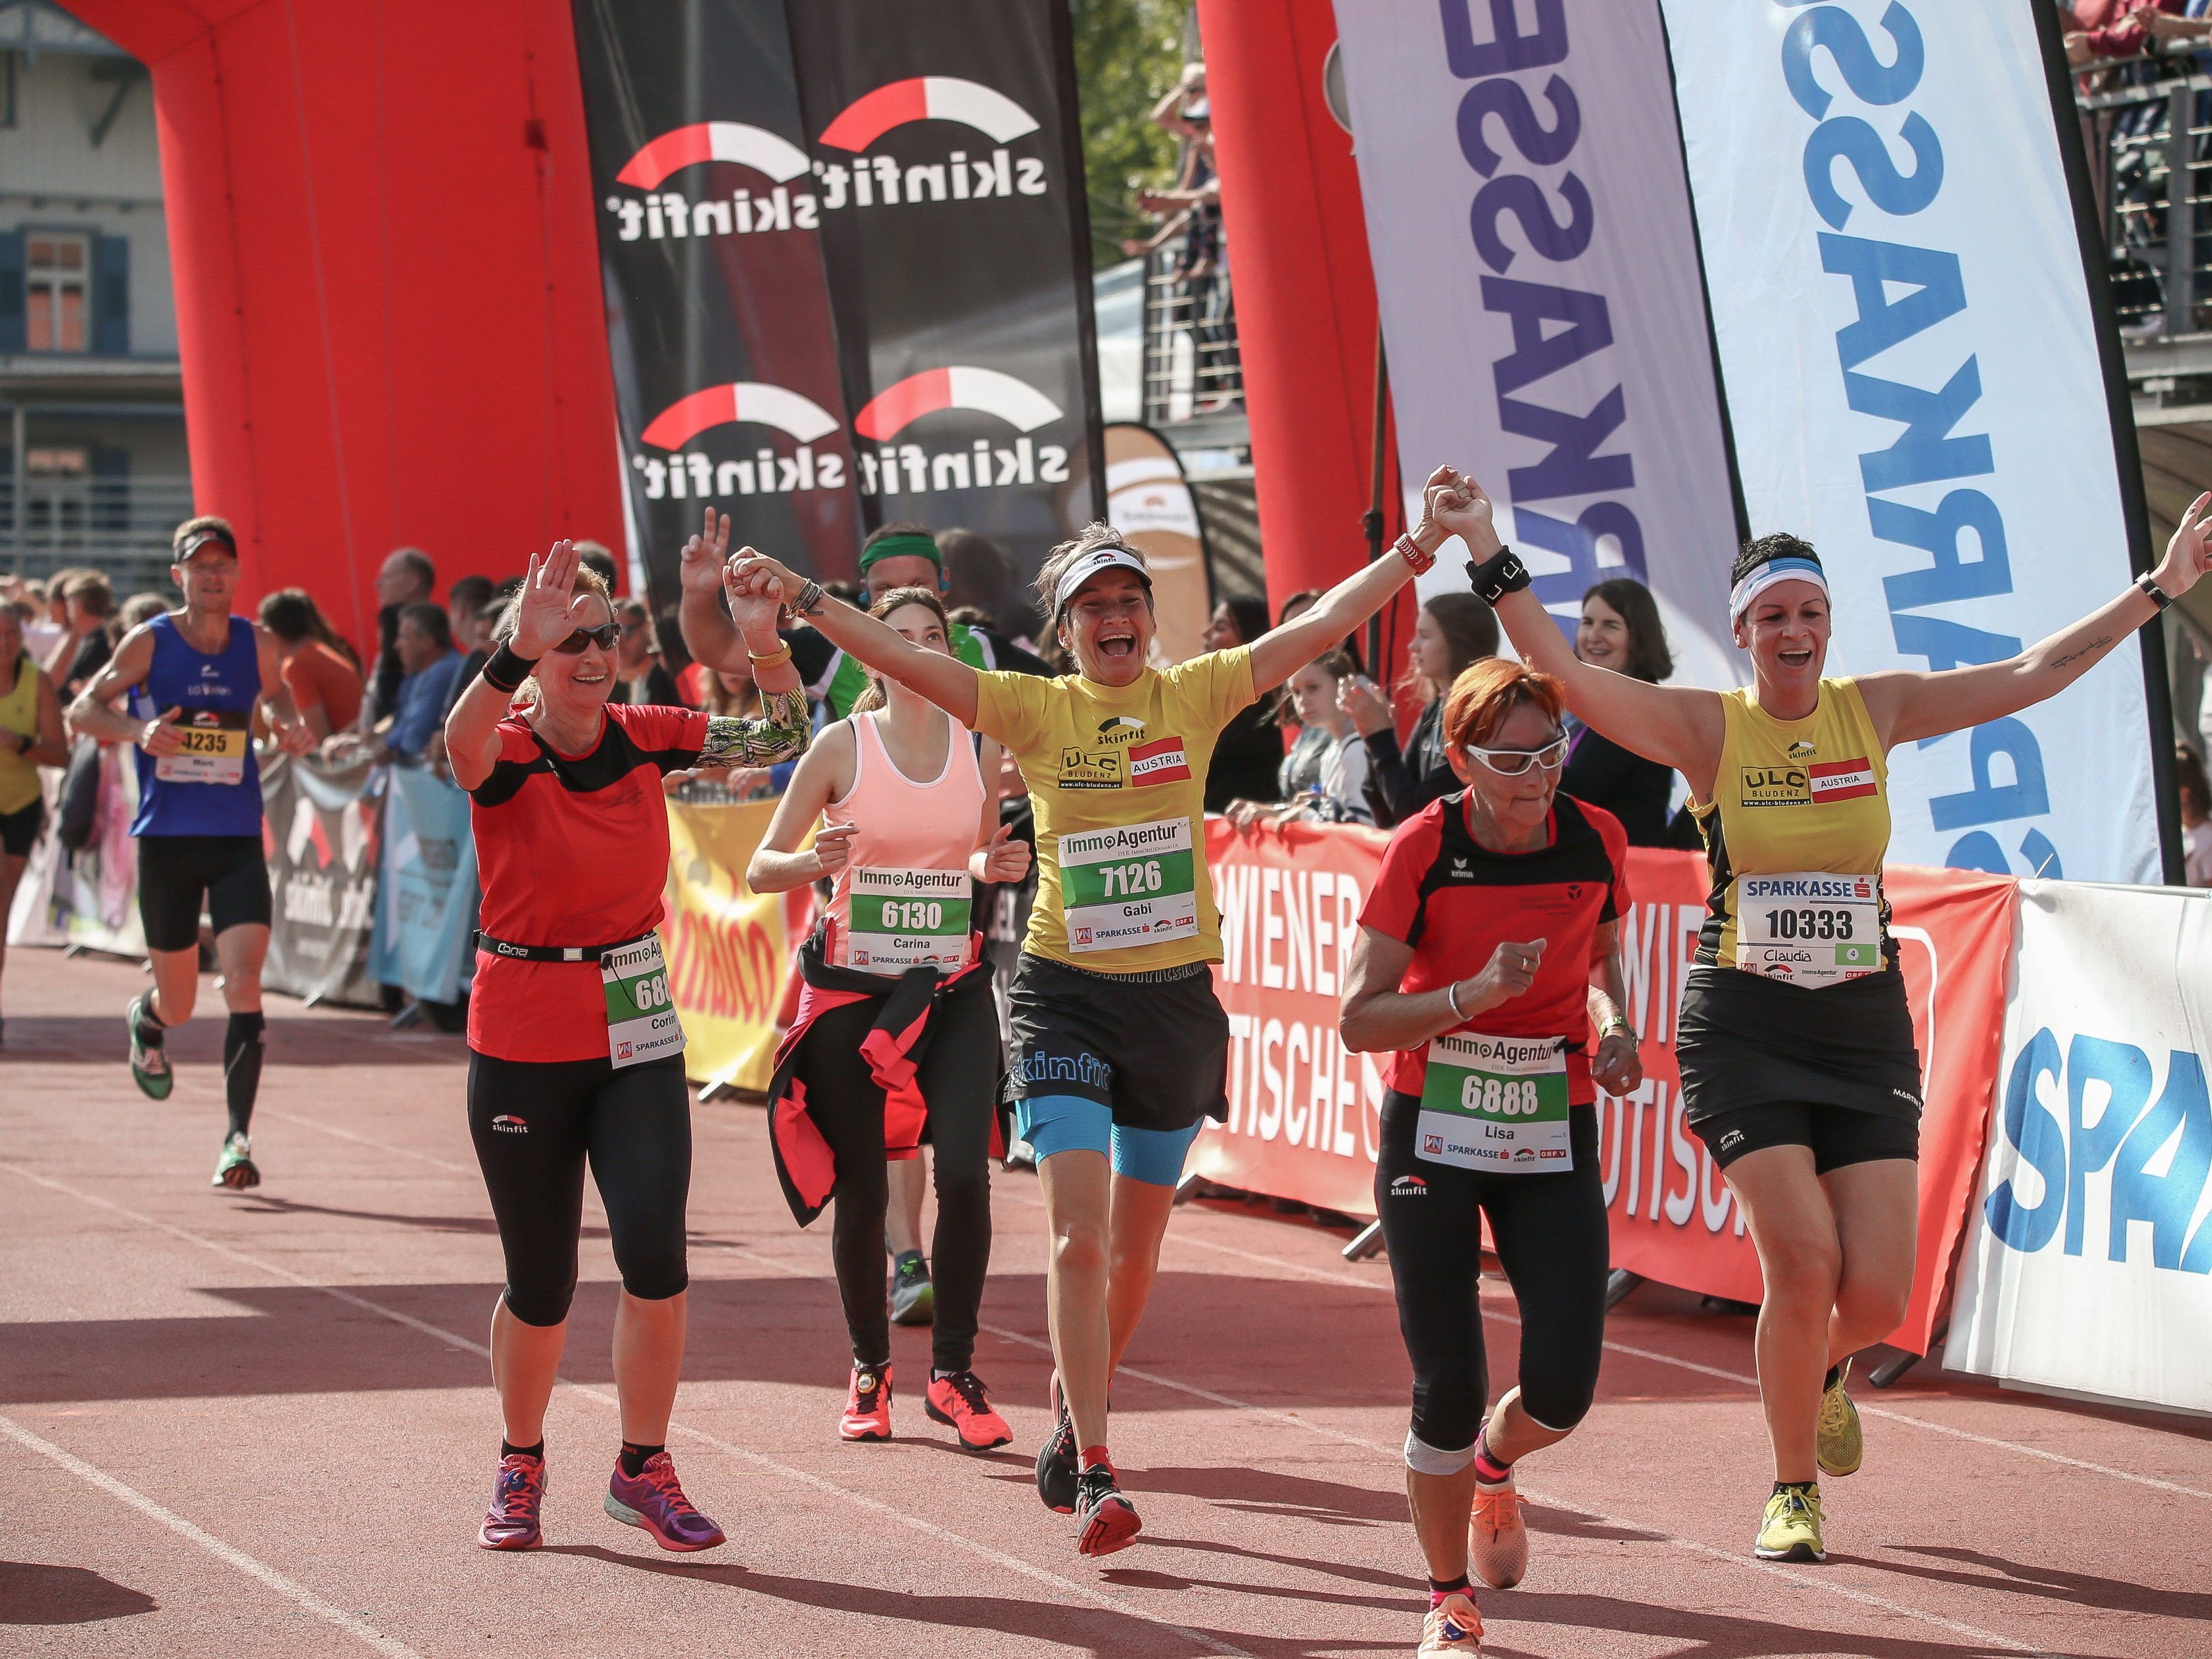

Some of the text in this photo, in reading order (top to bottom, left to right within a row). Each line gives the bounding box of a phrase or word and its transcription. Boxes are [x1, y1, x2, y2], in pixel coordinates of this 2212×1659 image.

[1097, 729, 1145, 745] skinfit
[1066, 751, 1117, 771] ULC
[1789, 749, 1817, 759] skinfit
[1134, 754, 1182, 773] AUSTRIA
[1068, 770, 1112, 779] BLUDENZ
[1745, 771, 1806, 788] ULC
[1821, 775, 1860, 788] AUSTRIA
[1067, 824, 1177, 854] ImmoAgentur
[859, 869, 962, 889] ImmoAgentur
[1099, 860, 1162, 897] 7126
[1451, 870, 1474, 878] erima
[1747, 881, 1852, 897] SPARKASSE
[882, 901, 942, 929] 6130
[1123, 903, 1152, 917] Gabi
[1096, 926, 1141, 939] SPARKASSE
[1215, 864, 1362, 996] WIENER
[1766, 909, 1853, 940] 10333
[893, 938, 930, 949] Carina
[872, 956, 912, 965] SPARKASSE
[1764, 949, 1812, 962] Claudia
[635, 1035, 674, 1052] SPARKASSE
[1227, 1013, 1354, 1157] TISCHE
[1461, 1075, 1538, 1115] 6888
[493, 1124, 528, 1134] skinfit
[1485, 1126, 1515, 1140] Lisa
[1721, 1134, 1745, 1151] skinfit
[1984, 1027, 2212, 1274] SPA
[1447, 1144, 1499, 1159] SPARKASSE
[1391, 1187, 1427, 1196] skinfit
